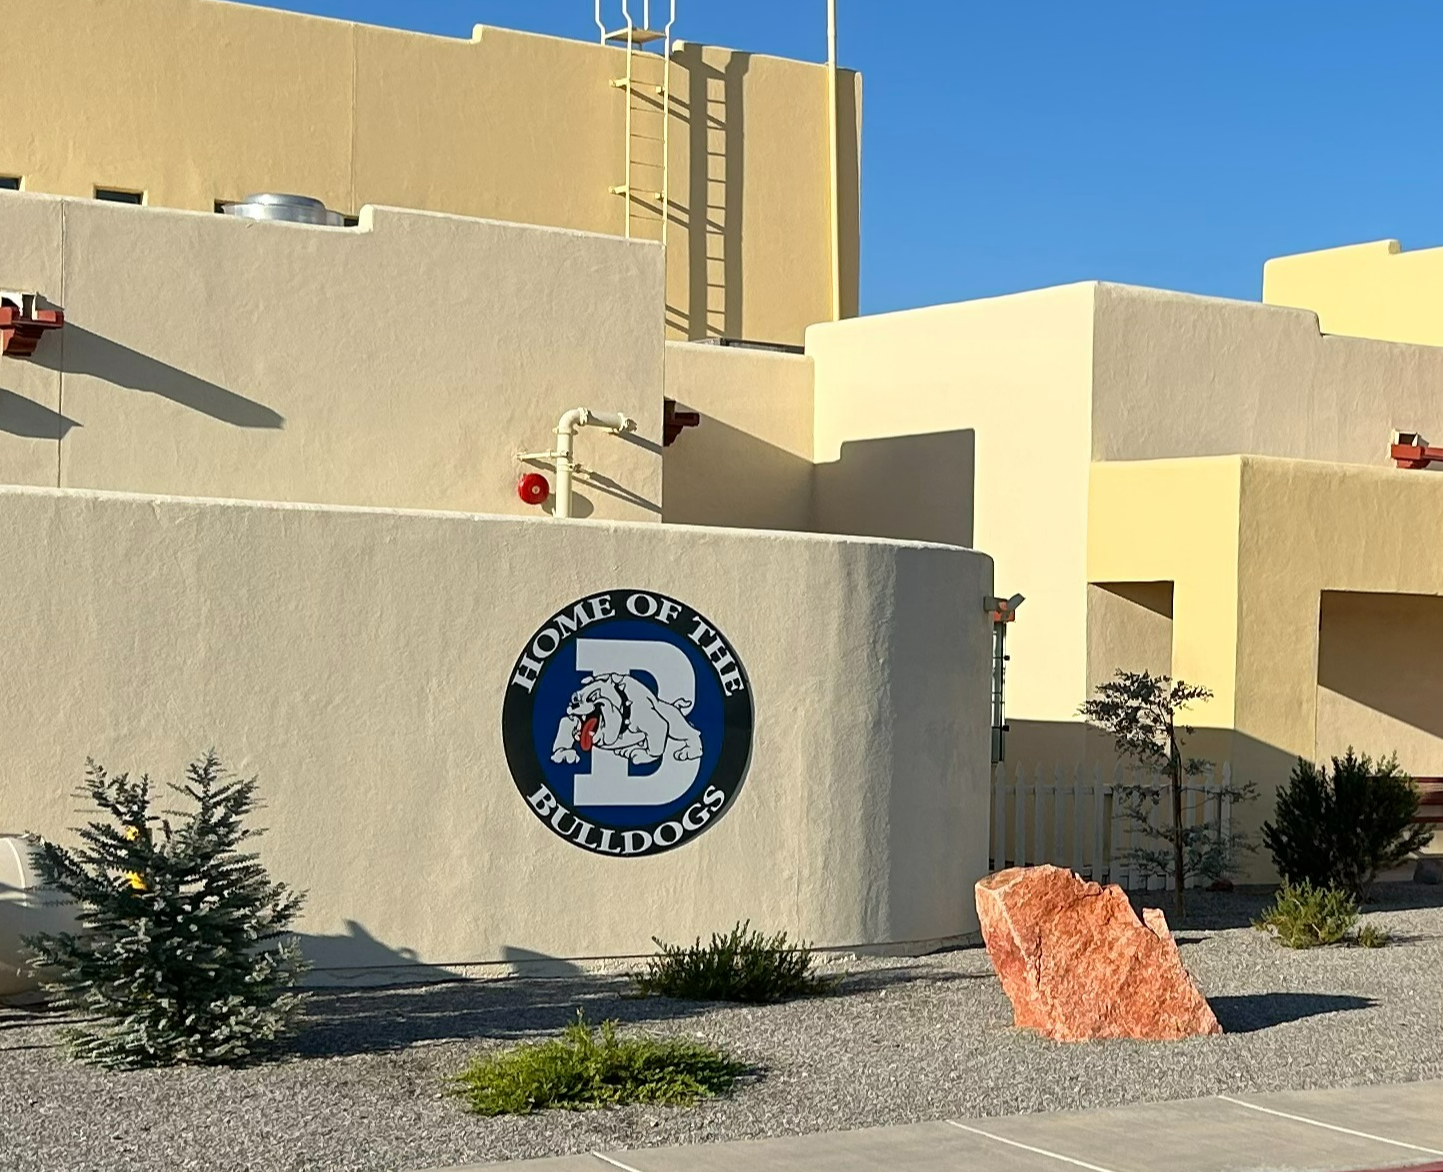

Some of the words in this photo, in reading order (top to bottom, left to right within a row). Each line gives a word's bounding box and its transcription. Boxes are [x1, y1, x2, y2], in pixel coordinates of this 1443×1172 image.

[511, 594, 616, 694] HOME
[625, 593, 682, 624] OF
[687, 615, 745, 697] THE
[526, 783, 726, 855] BULLDOGS
